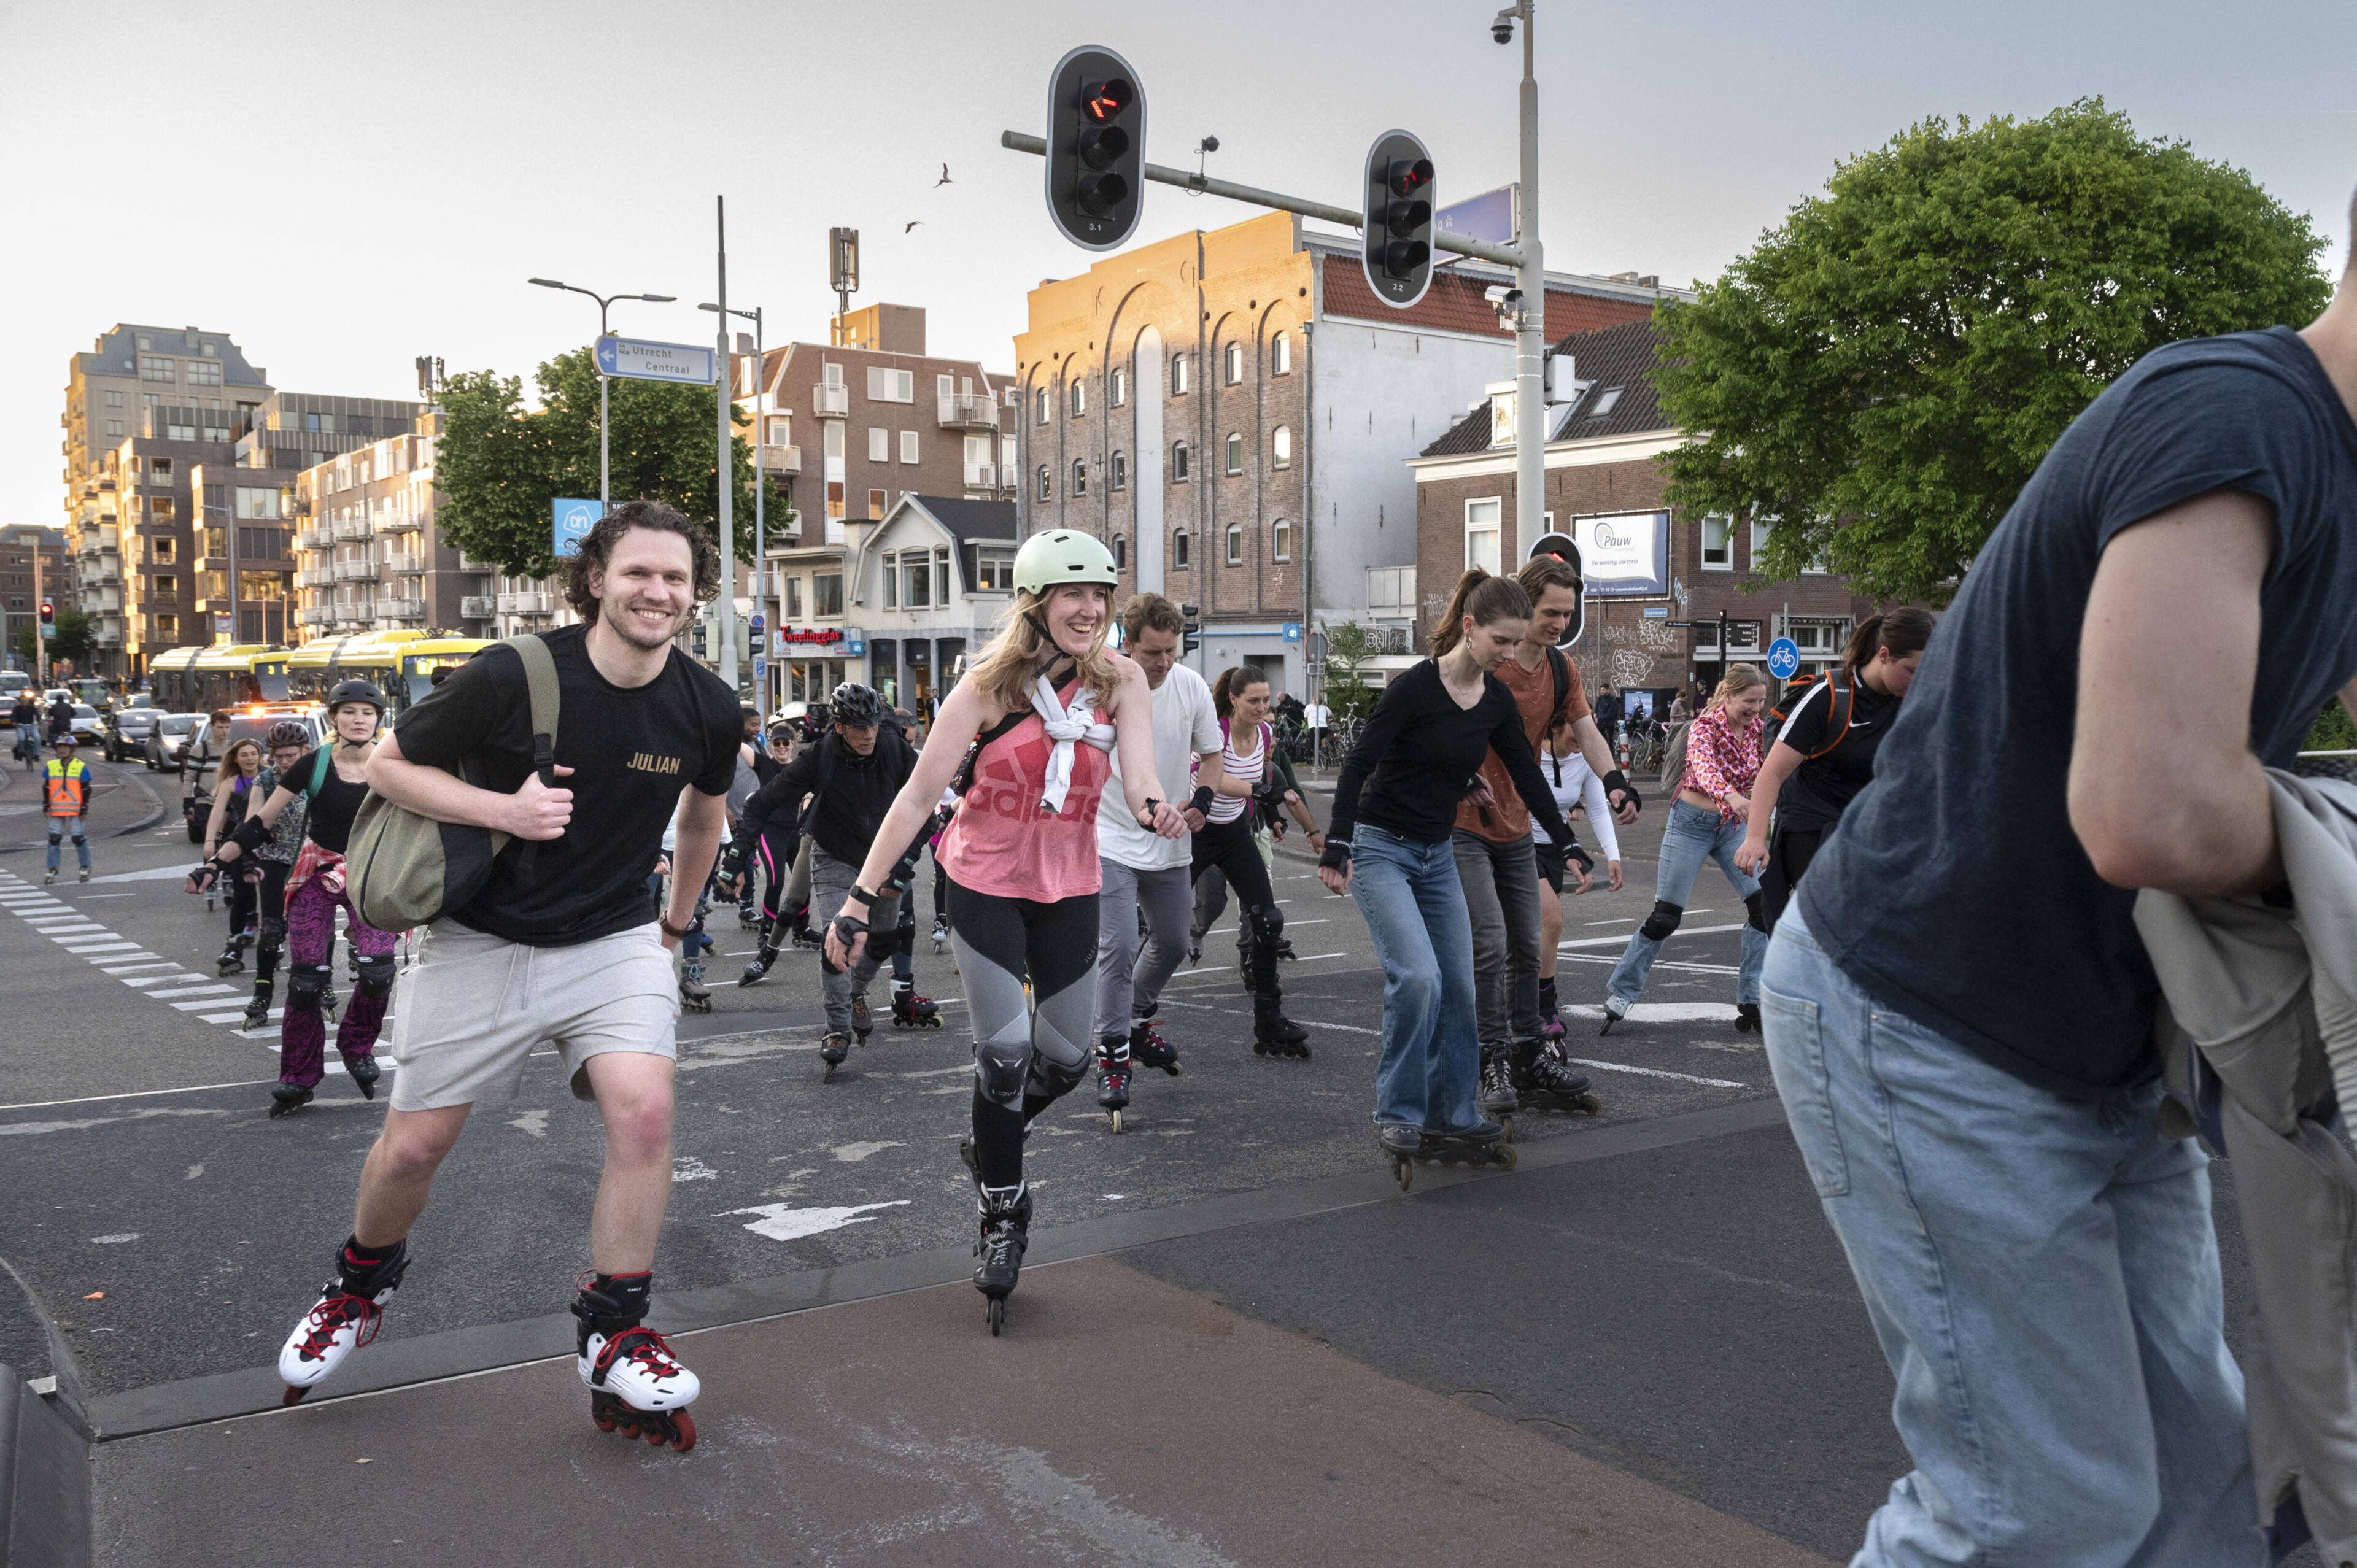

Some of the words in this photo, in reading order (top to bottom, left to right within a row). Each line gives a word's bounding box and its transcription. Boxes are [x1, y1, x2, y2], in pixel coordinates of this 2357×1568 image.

[1089, 223, 1101, 231] 3.1
[1393, 283, 1404, 292] 2.2
[632, 346, 672, 358] Utrecht
[645, 361, 690, 374] Centraal
[1604, 535, 1631, 547] Pauw
[780, 625, 840, 645] Tweelingglas
[627, 752, 681, 774] JULIAN
